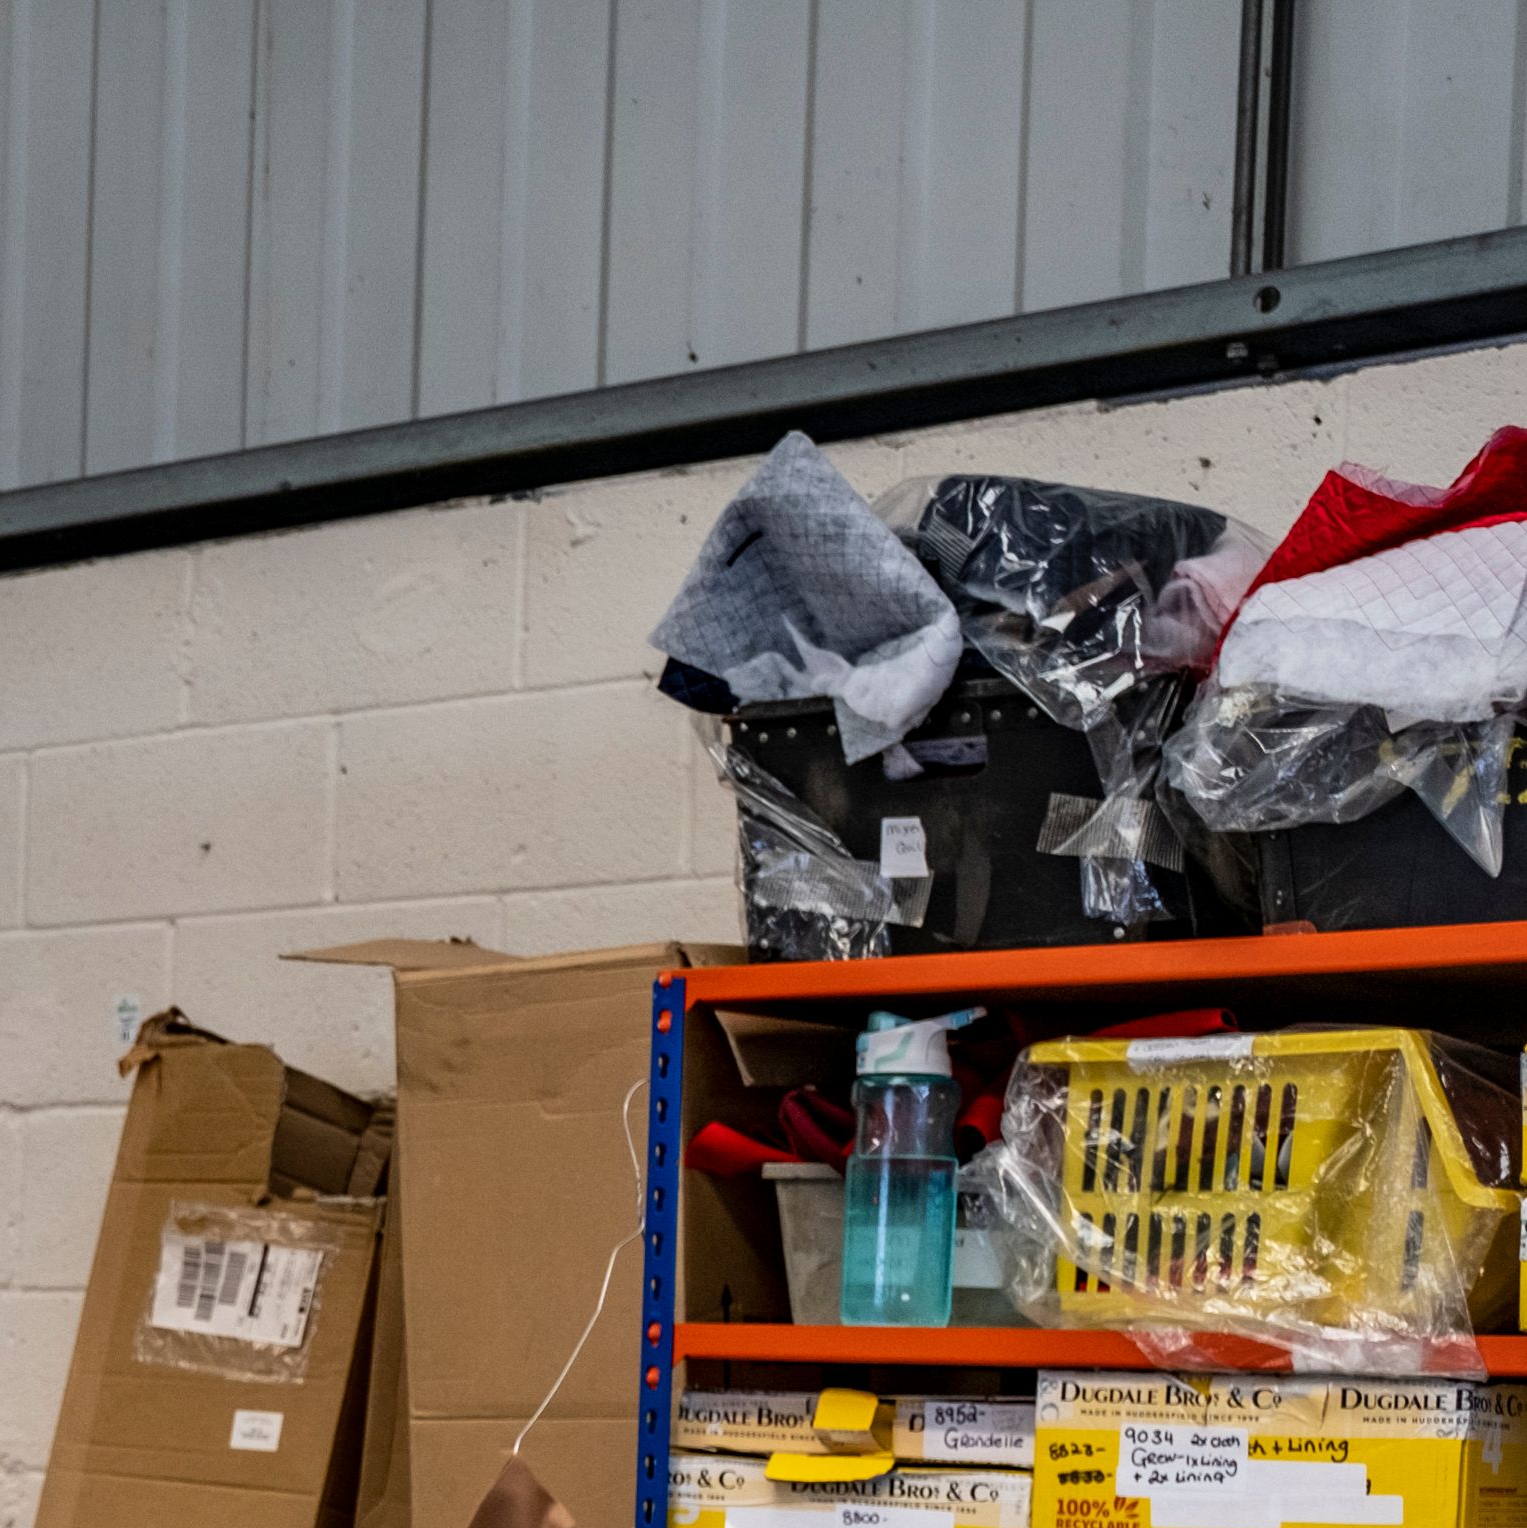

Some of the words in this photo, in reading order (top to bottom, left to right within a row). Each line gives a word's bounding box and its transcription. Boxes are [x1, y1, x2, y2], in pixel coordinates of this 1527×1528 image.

[1226, 1387, 1245, 1409] &
[1080, 1407, 1107, 1417] MADE
[1111, 1409, 1122, 1417] IN
[1363, 1416, 1392, 1424] MADE
[1396, 1416, 1407, 1424] IN
[1124, 1427, 1175, 1446] 9034
[1288, 1438, 1349, 1463] Lining
[697, 1468, 712, 1489] &
[946, 1481, 963, 1502] &
[1056, 1498, 1110, 1518] 100%
